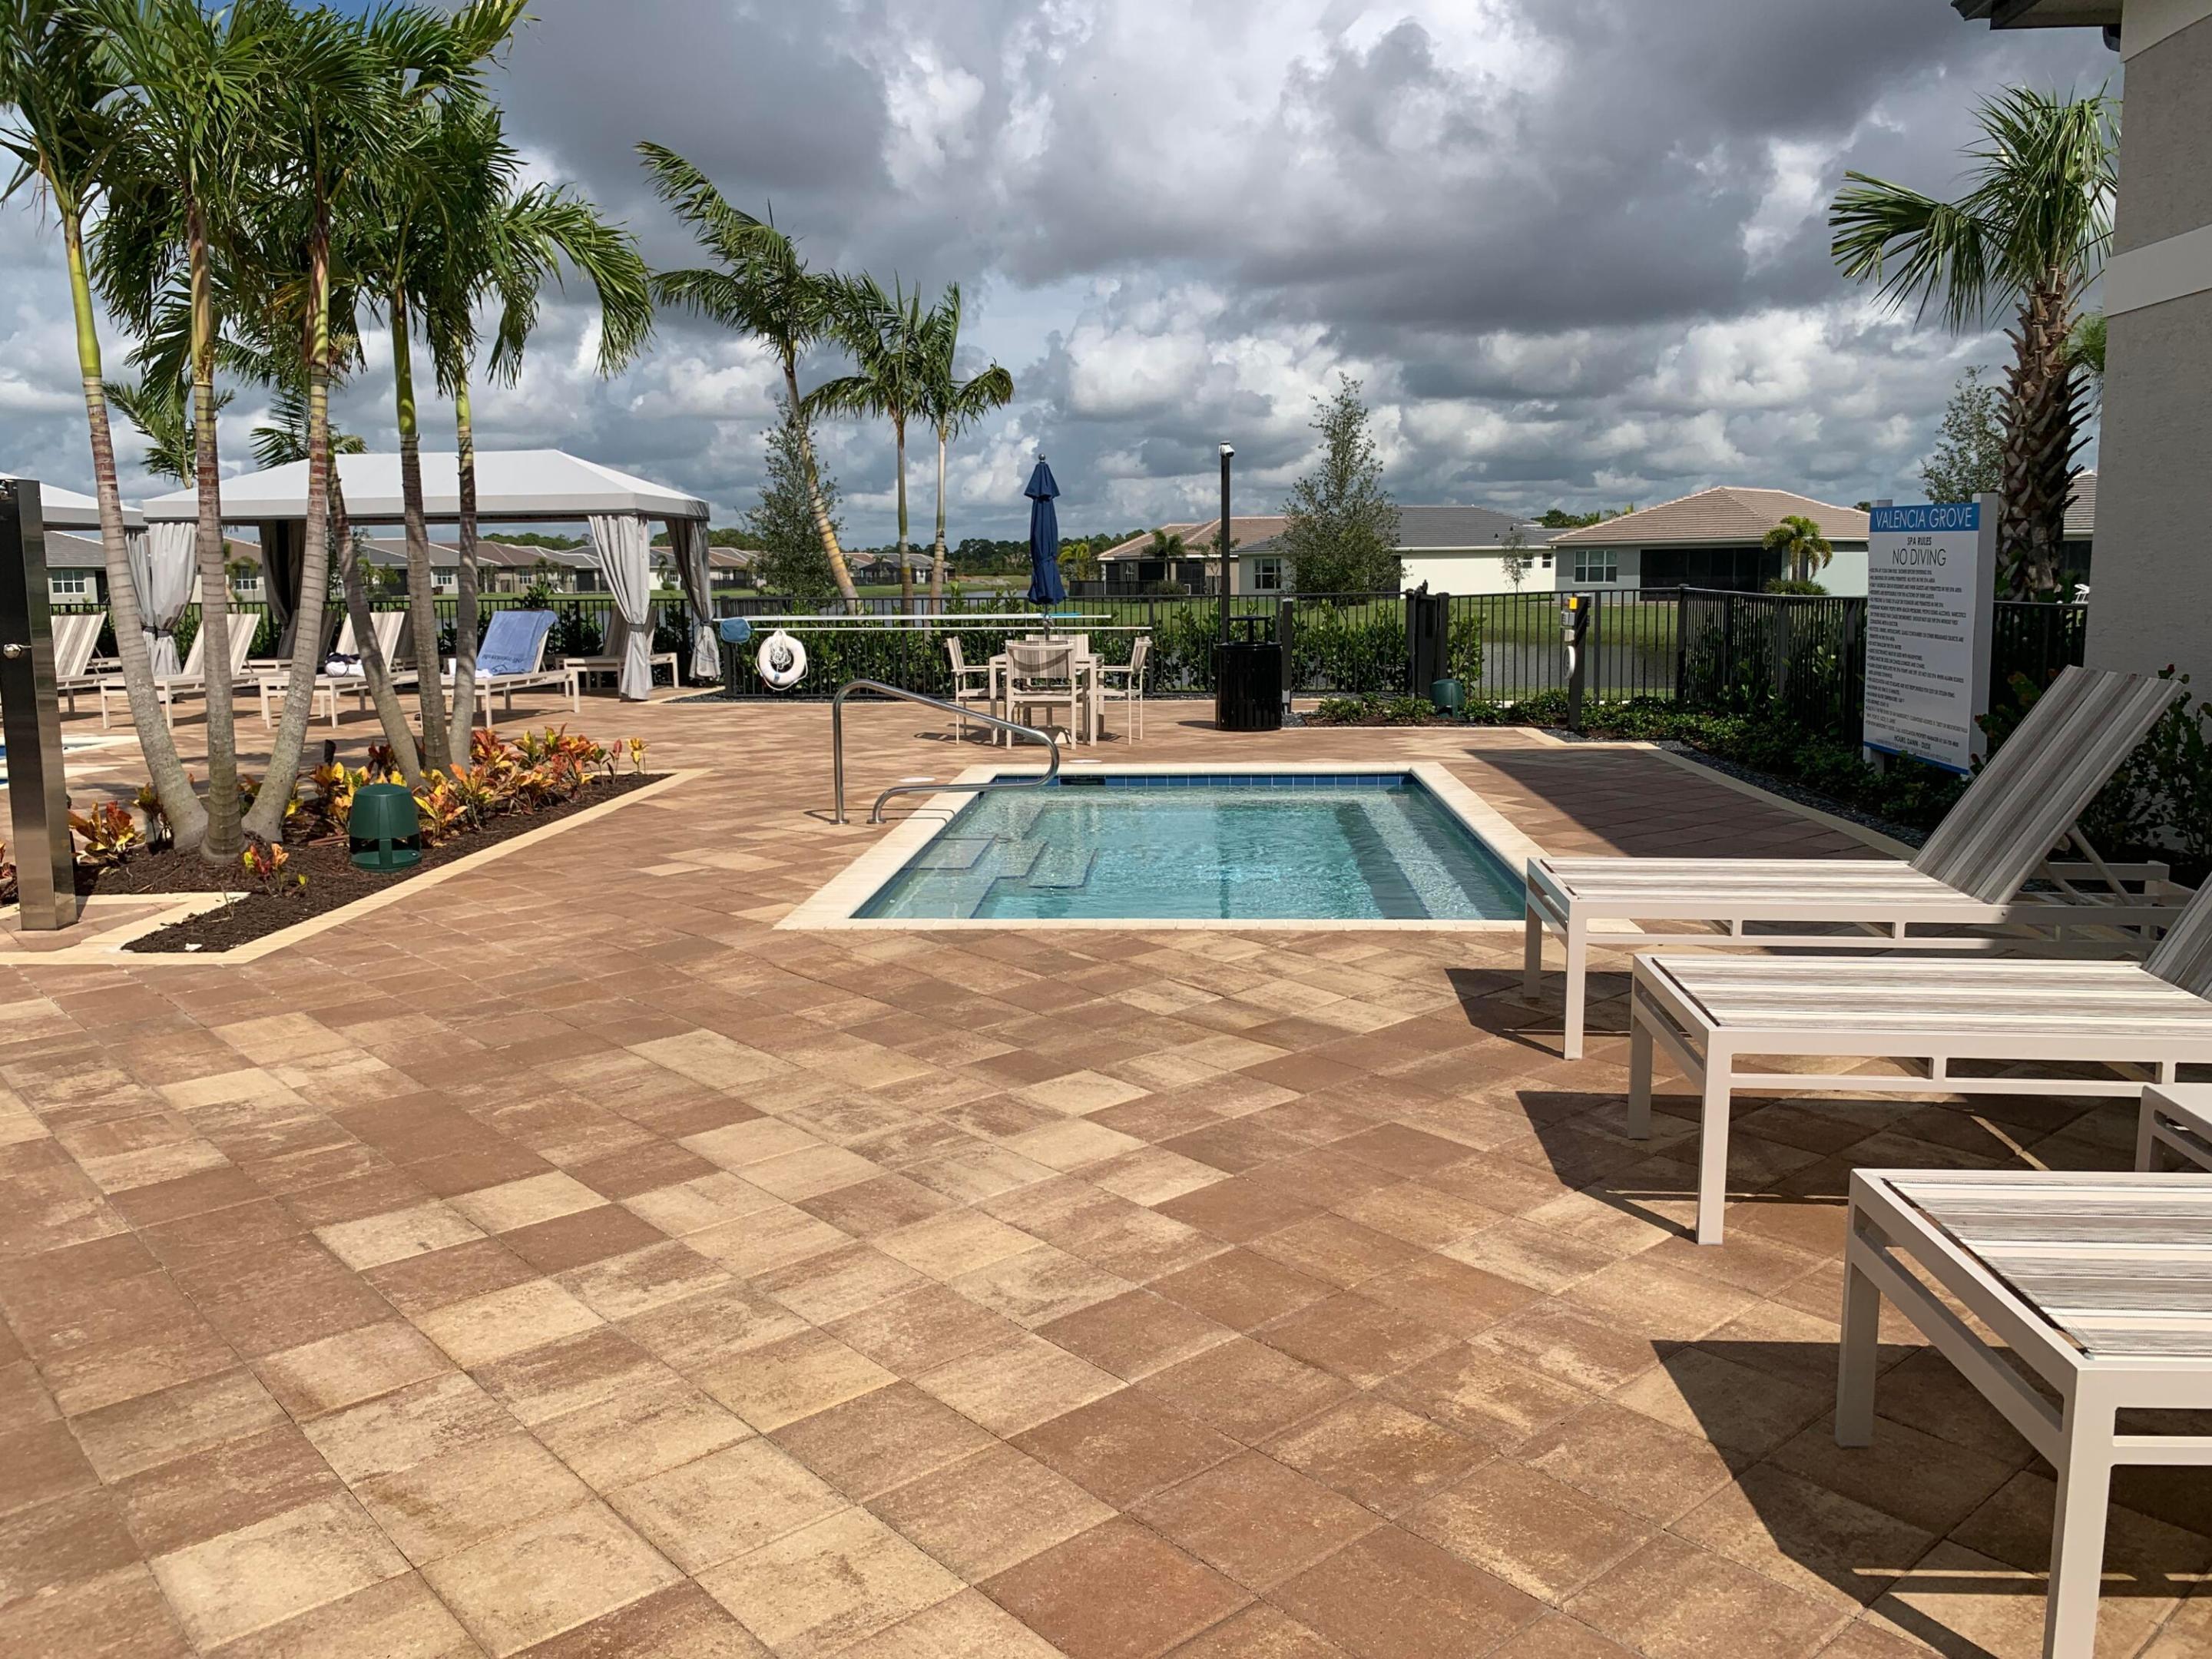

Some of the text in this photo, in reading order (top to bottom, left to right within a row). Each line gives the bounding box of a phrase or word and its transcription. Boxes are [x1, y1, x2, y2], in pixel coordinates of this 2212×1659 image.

[1876, 507, 1972, 528] VALENCIA GROVE
[1907, 536, 1932, 546] SPA RULES
[1892, 548, 1946, 566] NO DIVING
